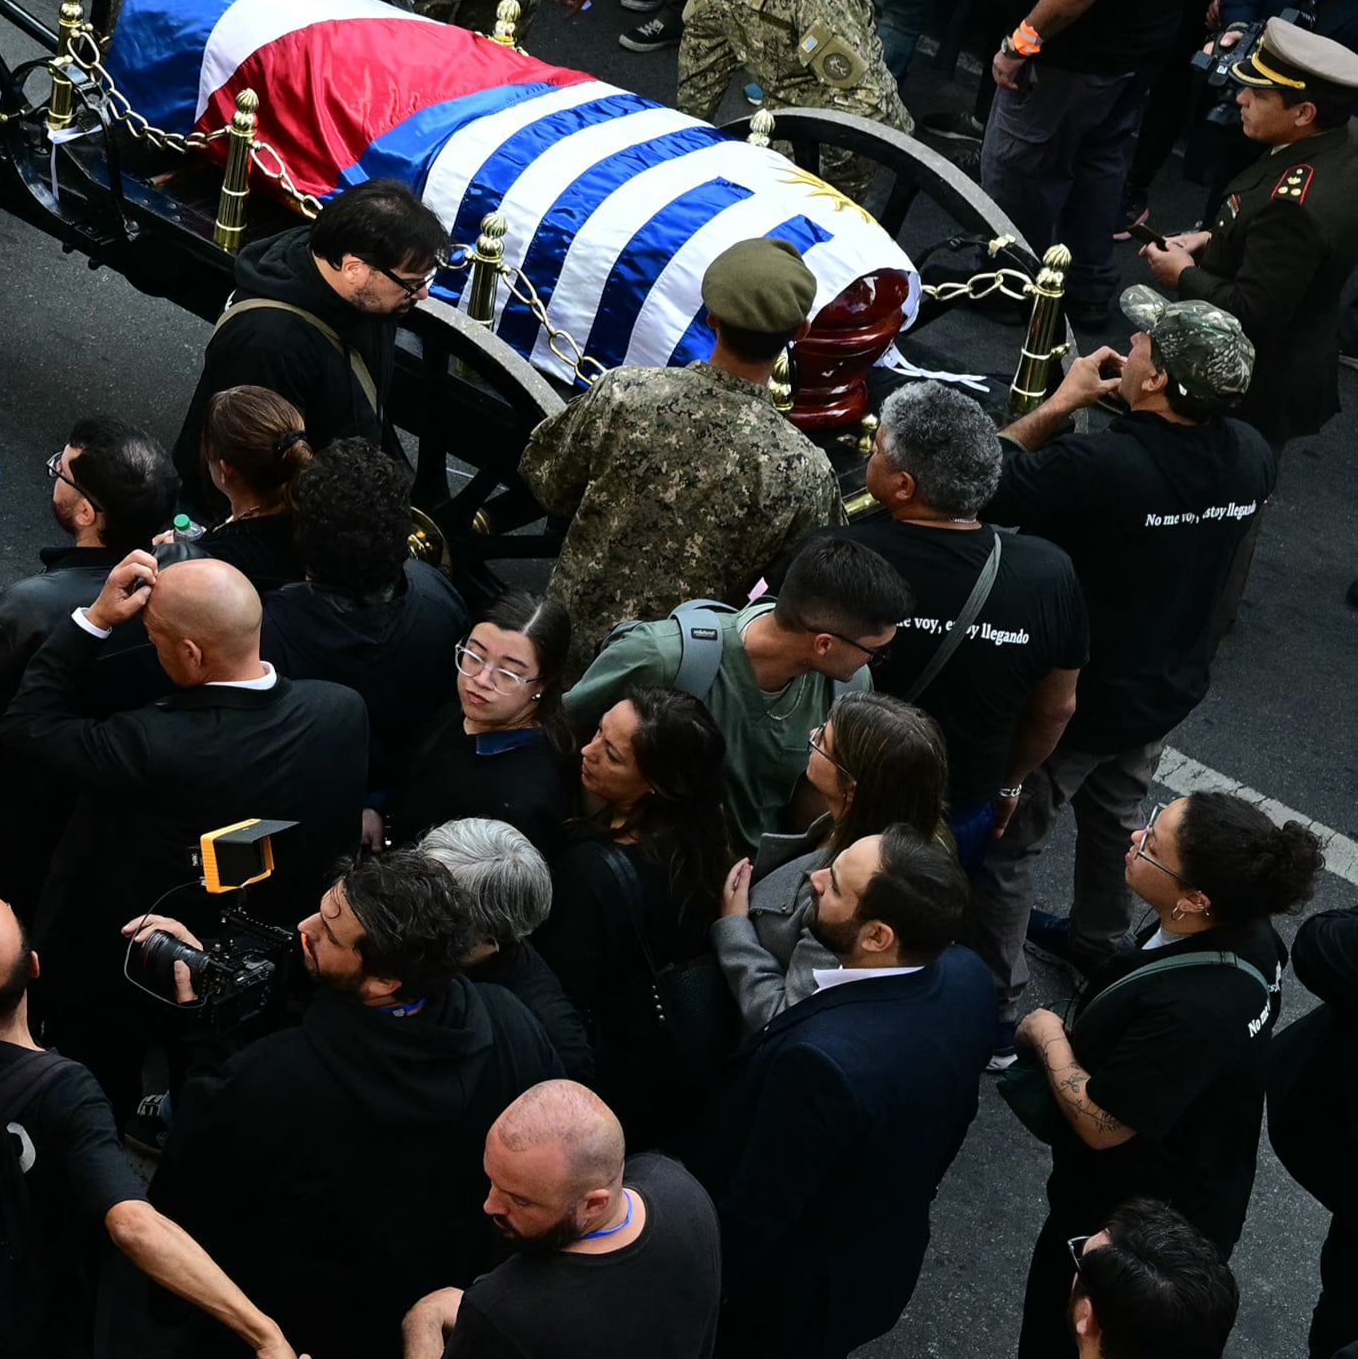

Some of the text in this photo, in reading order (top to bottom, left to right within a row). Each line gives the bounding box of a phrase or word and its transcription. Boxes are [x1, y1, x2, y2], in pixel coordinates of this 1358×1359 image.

[1145, 514, 1162, 526] No
[1163, 515, 1180, 525] me
[1202, 506, 1227, 520] stoy
[895, 618, 911, 627] e
[914, 618, 942, 634] voy,
[981, 623, 1030, 645] llegando
[1248, 1019, 1261, 1038] No
